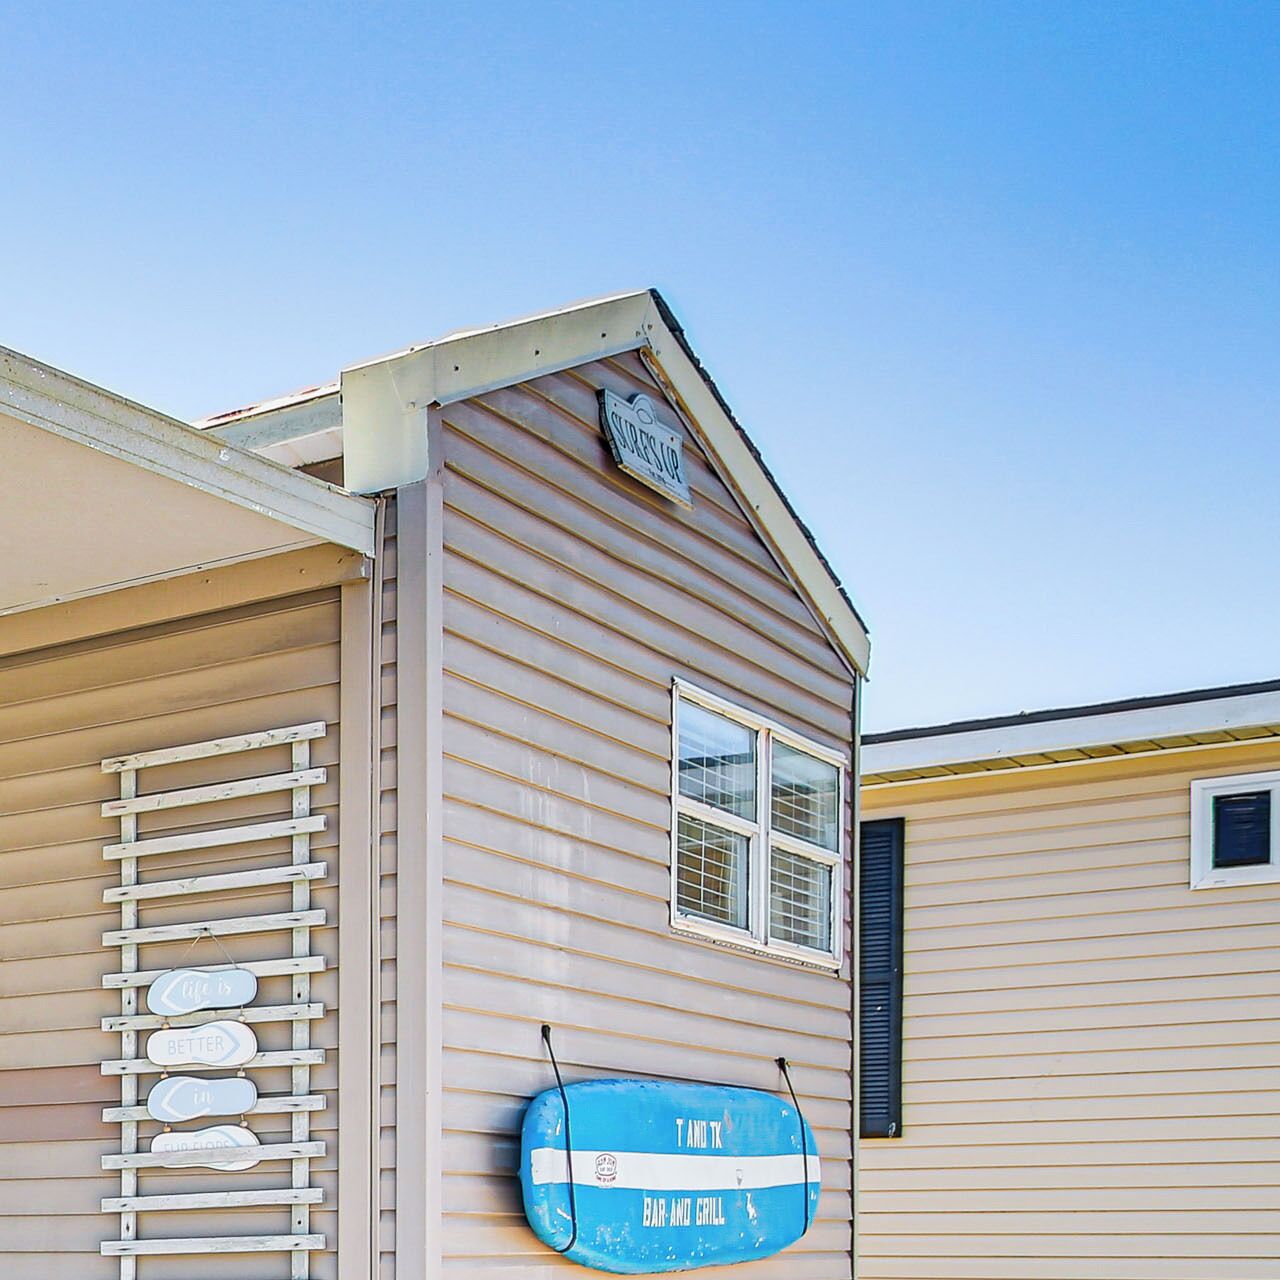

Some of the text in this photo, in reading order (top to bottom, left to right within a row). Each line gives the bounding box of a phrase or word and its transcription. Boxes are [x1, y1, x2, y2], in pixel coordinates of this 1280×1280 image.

[660, 441, 682, 484] UP
[182, 977, 232, 1005] life is
[168, 1036, 225, 1056] BETTER
[194, 1087, 215, 1105] in
[676, 1118, 684, 1147] T
[687, 1119, 707, 1148] AND
[642, 1197, 726, 1227] BAR AND GRILL
